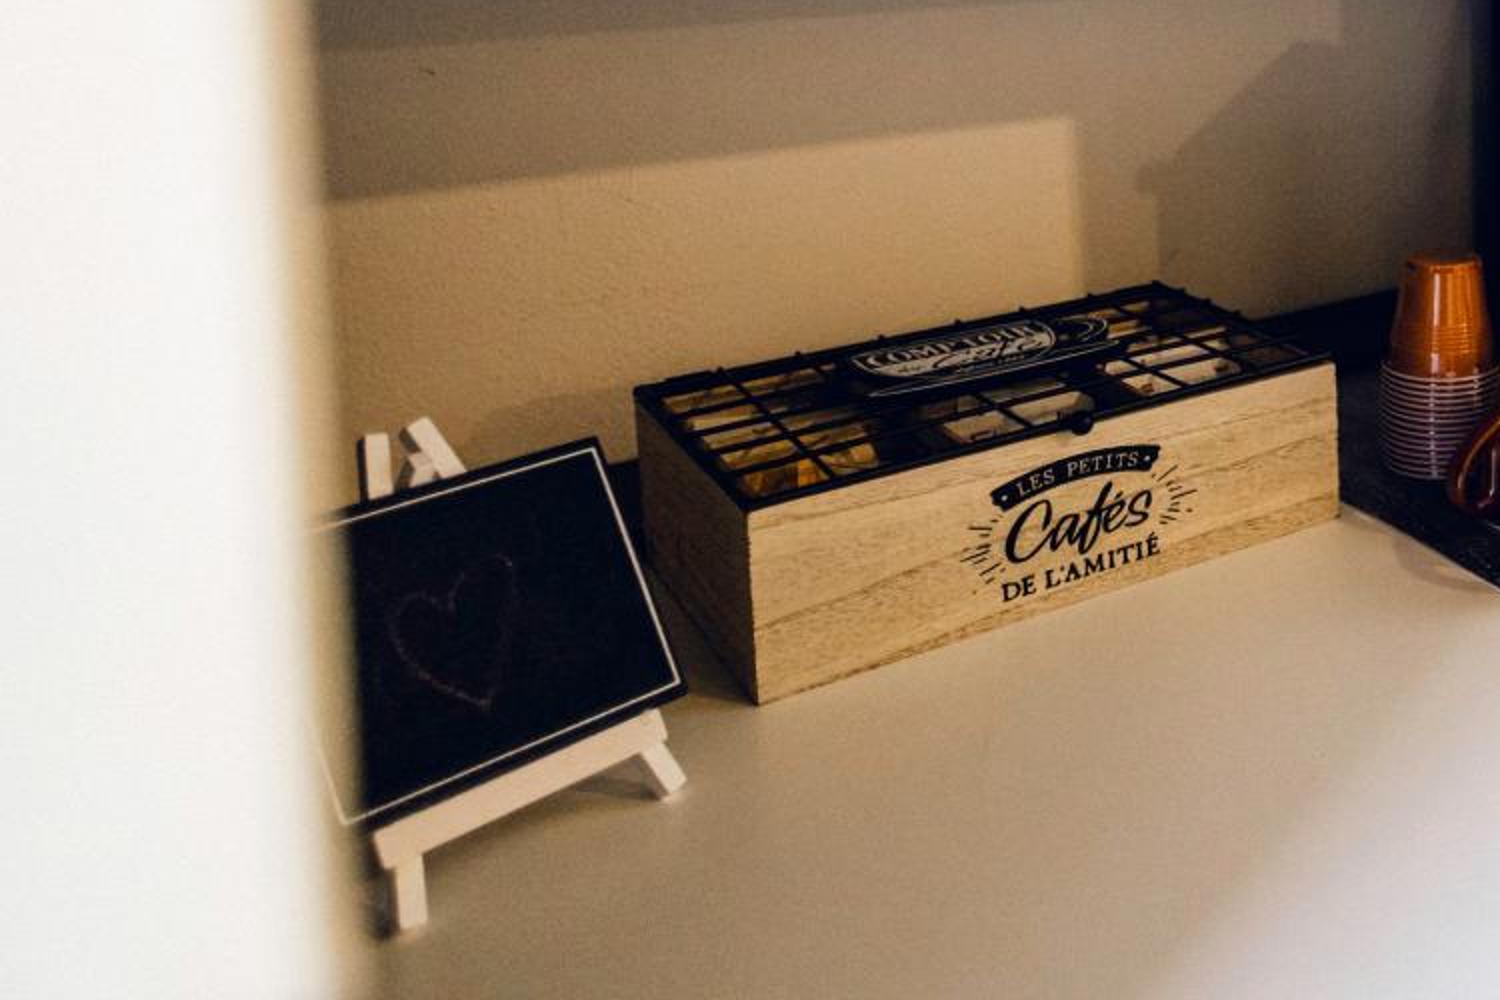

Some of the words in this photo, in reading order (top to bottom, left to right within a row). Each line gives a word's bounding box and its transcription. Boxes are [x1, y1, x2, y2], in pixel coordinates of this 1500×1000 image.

[1016, 468, 1055, 497] LES
[1066, 451, 1140, 478] PETITS
[1005, 481, 1153, 564] Cafés
[1001, 574, 1037, 602] DE
[1045, 532, 1161, 590] L'AMITIÉ
